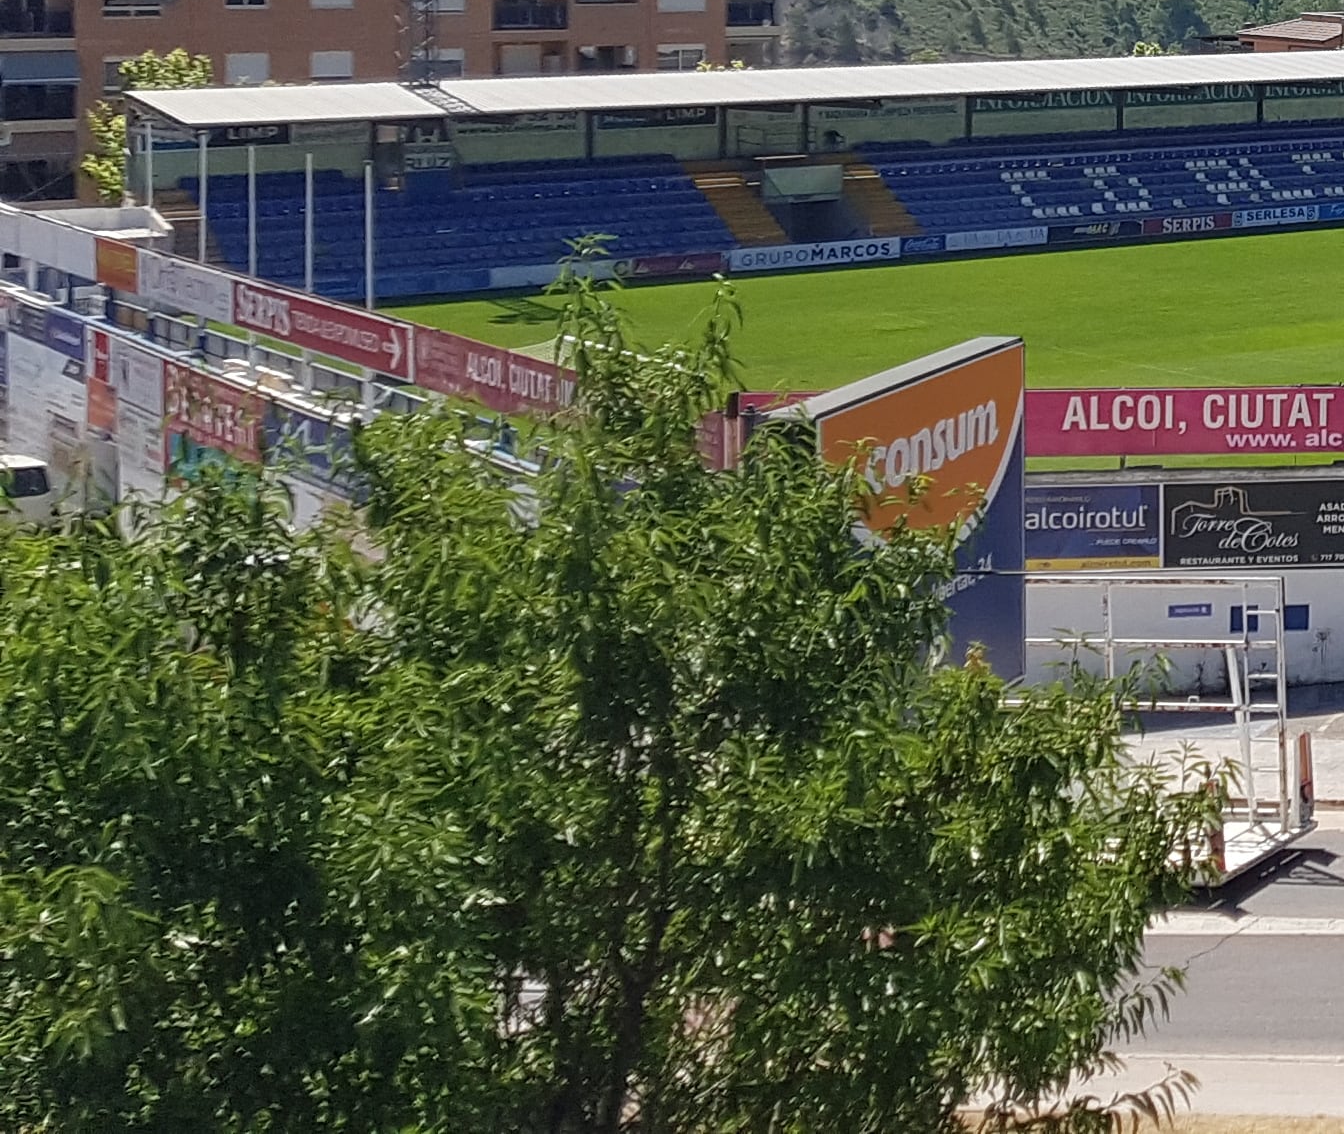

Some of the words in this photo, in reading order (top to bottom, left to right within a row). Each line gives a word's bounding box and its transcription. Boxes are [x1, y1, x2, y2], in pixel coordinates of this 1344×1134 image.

[1162, 216, 1215, 233] SERPIS
[1246, 207, 1306, 222] SERLESA
[741, 242, 891, 267] GRUPOMARCOS
[1061, 394, 1188, 435] ALCOI,
[1203, 392, 1335, 429] CIUTAT
[1025, 505, 1146, 530] alcoirotul
[1179, 514, 1235, 538] Torre
[1218, 531, 1242, 549] de
[1235, 517, 1299, 552] Cotes
[1180, 556, 1246, 566] RESTAURANTE
[1248, 556, 1255, 564] Y
[1256, 554, 1299, 564] EVENTOS
